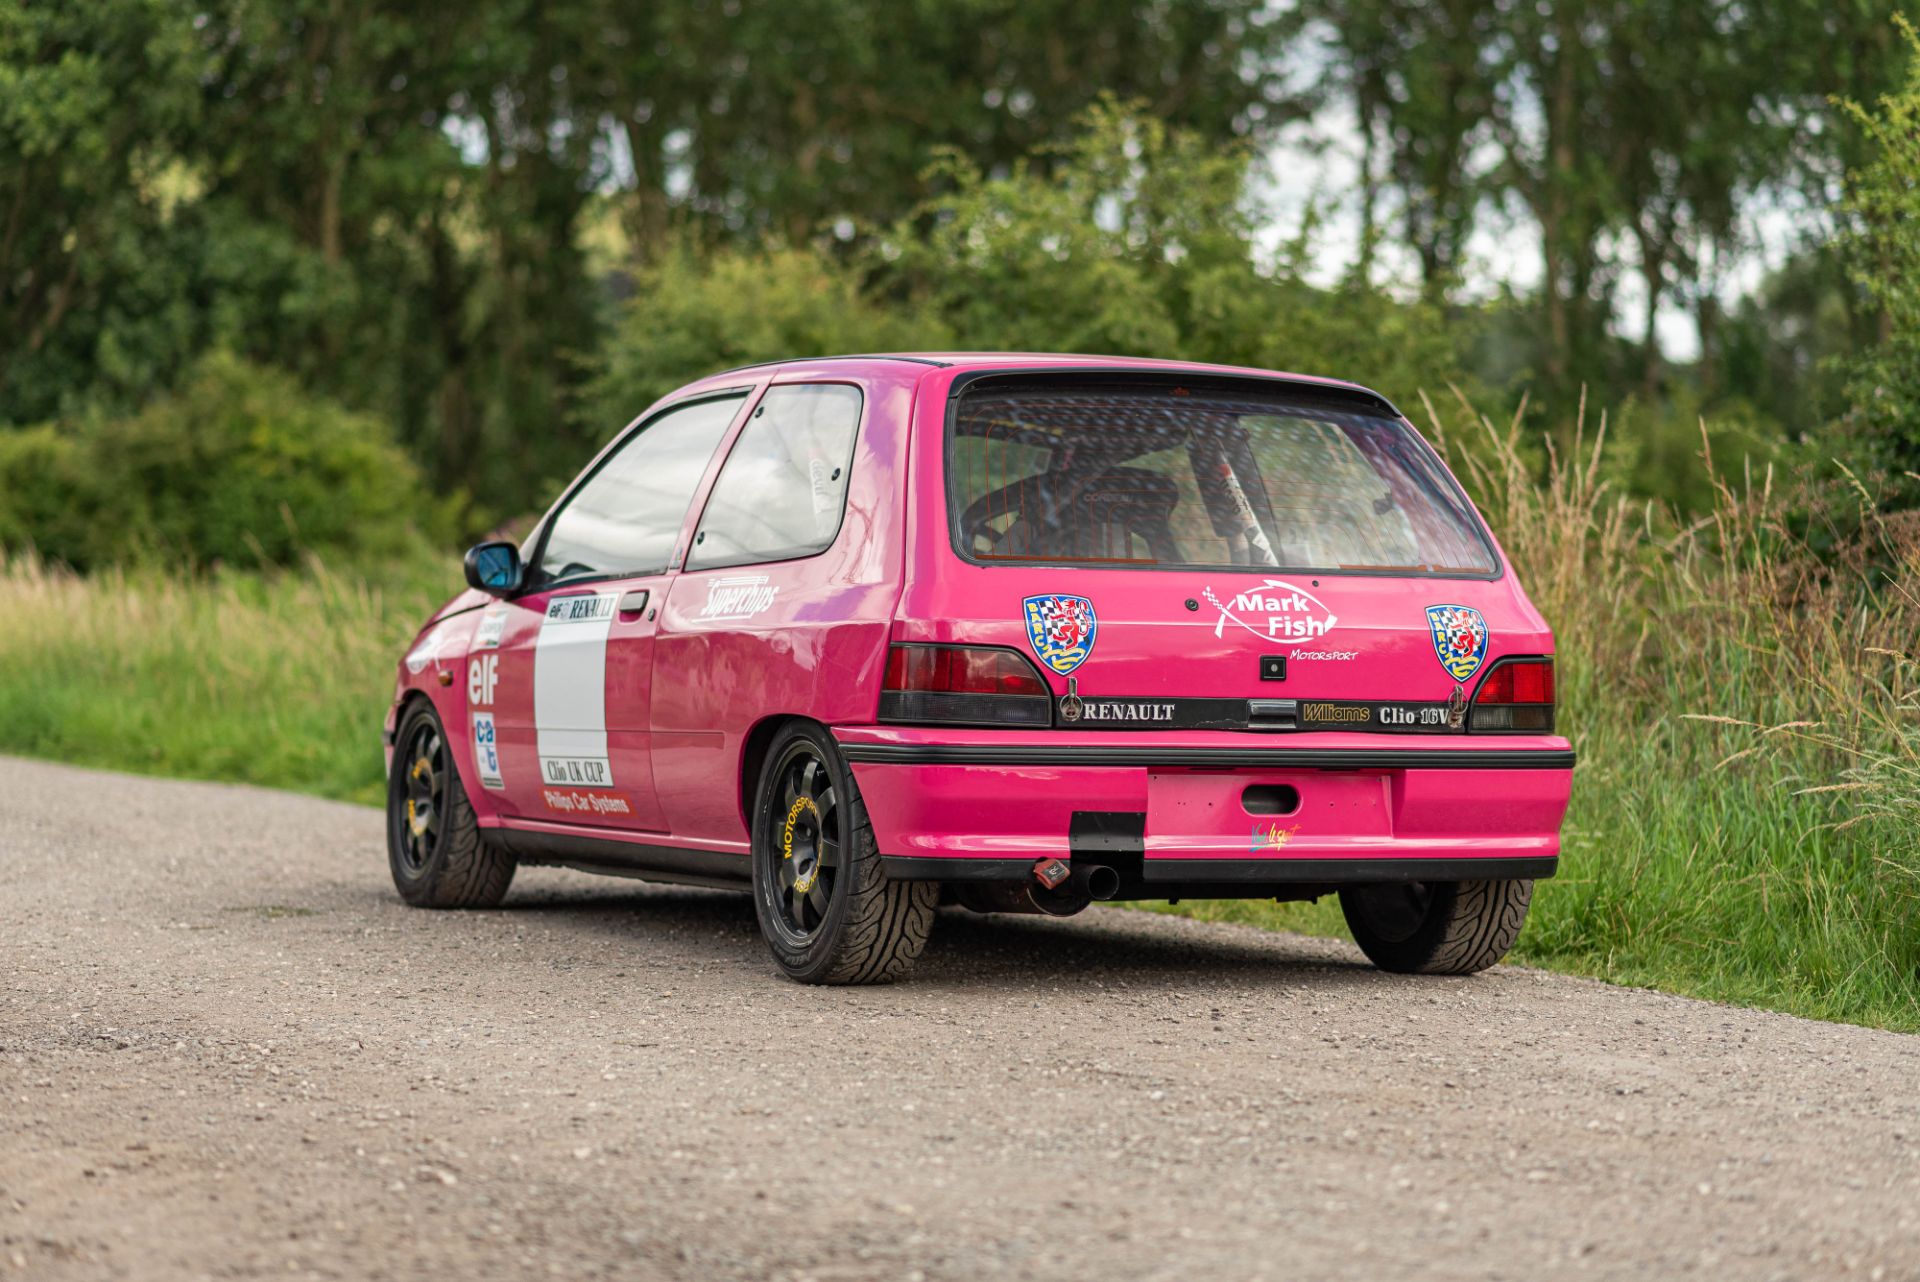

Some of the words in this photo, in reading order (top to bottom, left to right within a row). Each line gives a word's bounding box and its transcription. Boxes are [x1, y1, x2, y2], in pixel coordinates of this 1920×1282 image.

[568, 598, 617, 619] RENAULT
[700, 580, 780, 617] Superchips
[1236, 593, 1310, 612] Mark
[1027, 603, 1045, 647] BARC
[1268, 615, 1324, 637] Fish
[1430, 612, 1447, 654] BARC
[468, 655, 499, 706] elf
[1083, 703, 1176, 721] RENAULT
[1380, 707, 1415, 724] Clio
[1420, 708, 1450, 724] 16V
[547, 760, 567, 781] Clio
[566, 761, 584, 782] UK
[584, 761, 604, 783] CUP
[572, 792, 591, 811] Car
[588, 792, 630, 815] Systems
[784, 796, 819, 860] MOTORSPORT
